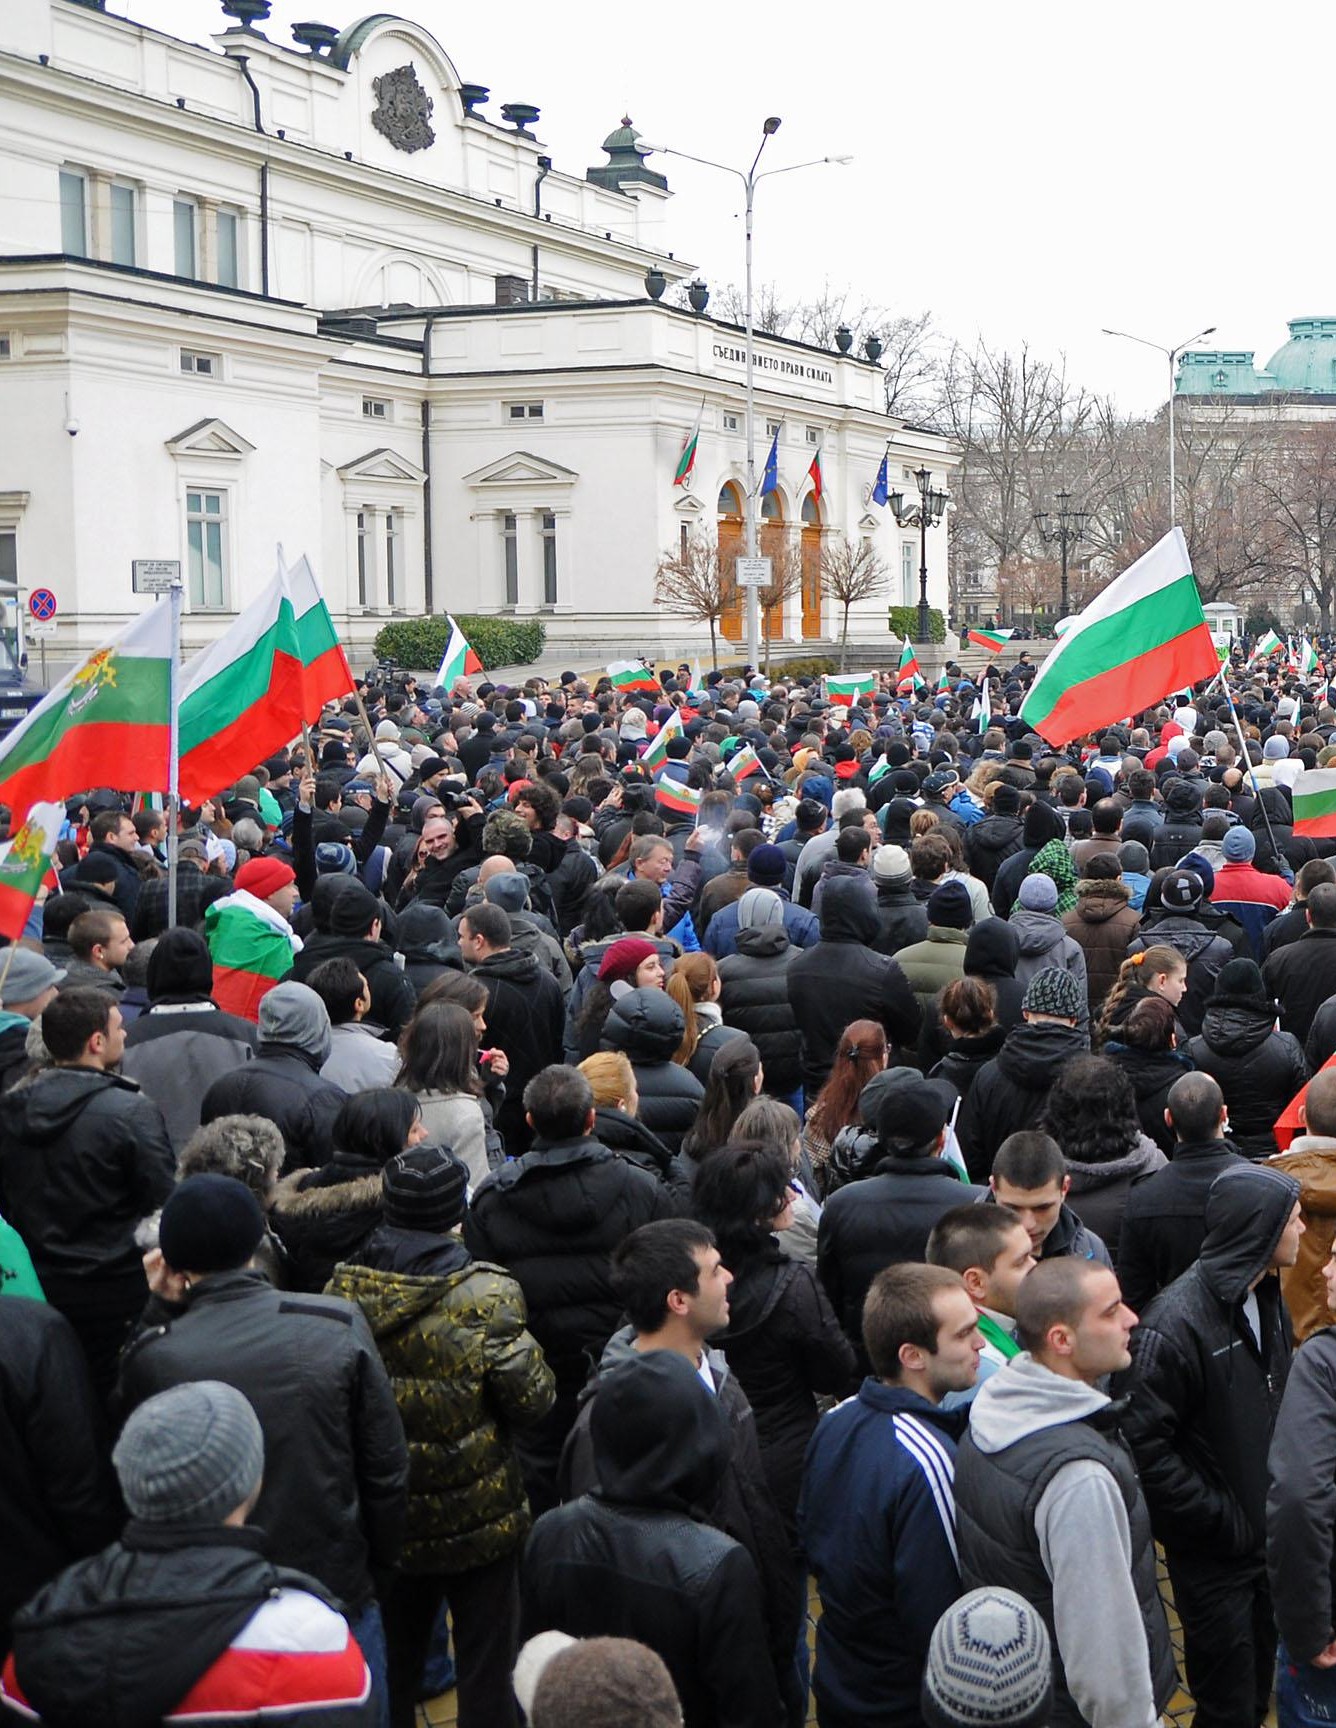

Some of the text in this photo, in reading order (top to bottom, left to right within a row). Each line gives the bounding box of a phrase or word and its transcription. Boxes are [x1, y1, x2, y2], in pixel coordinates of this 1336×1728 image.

[713, 345, 832, 383] СЪЕДИННИЕТО ПРАВИ СИЛАТА
